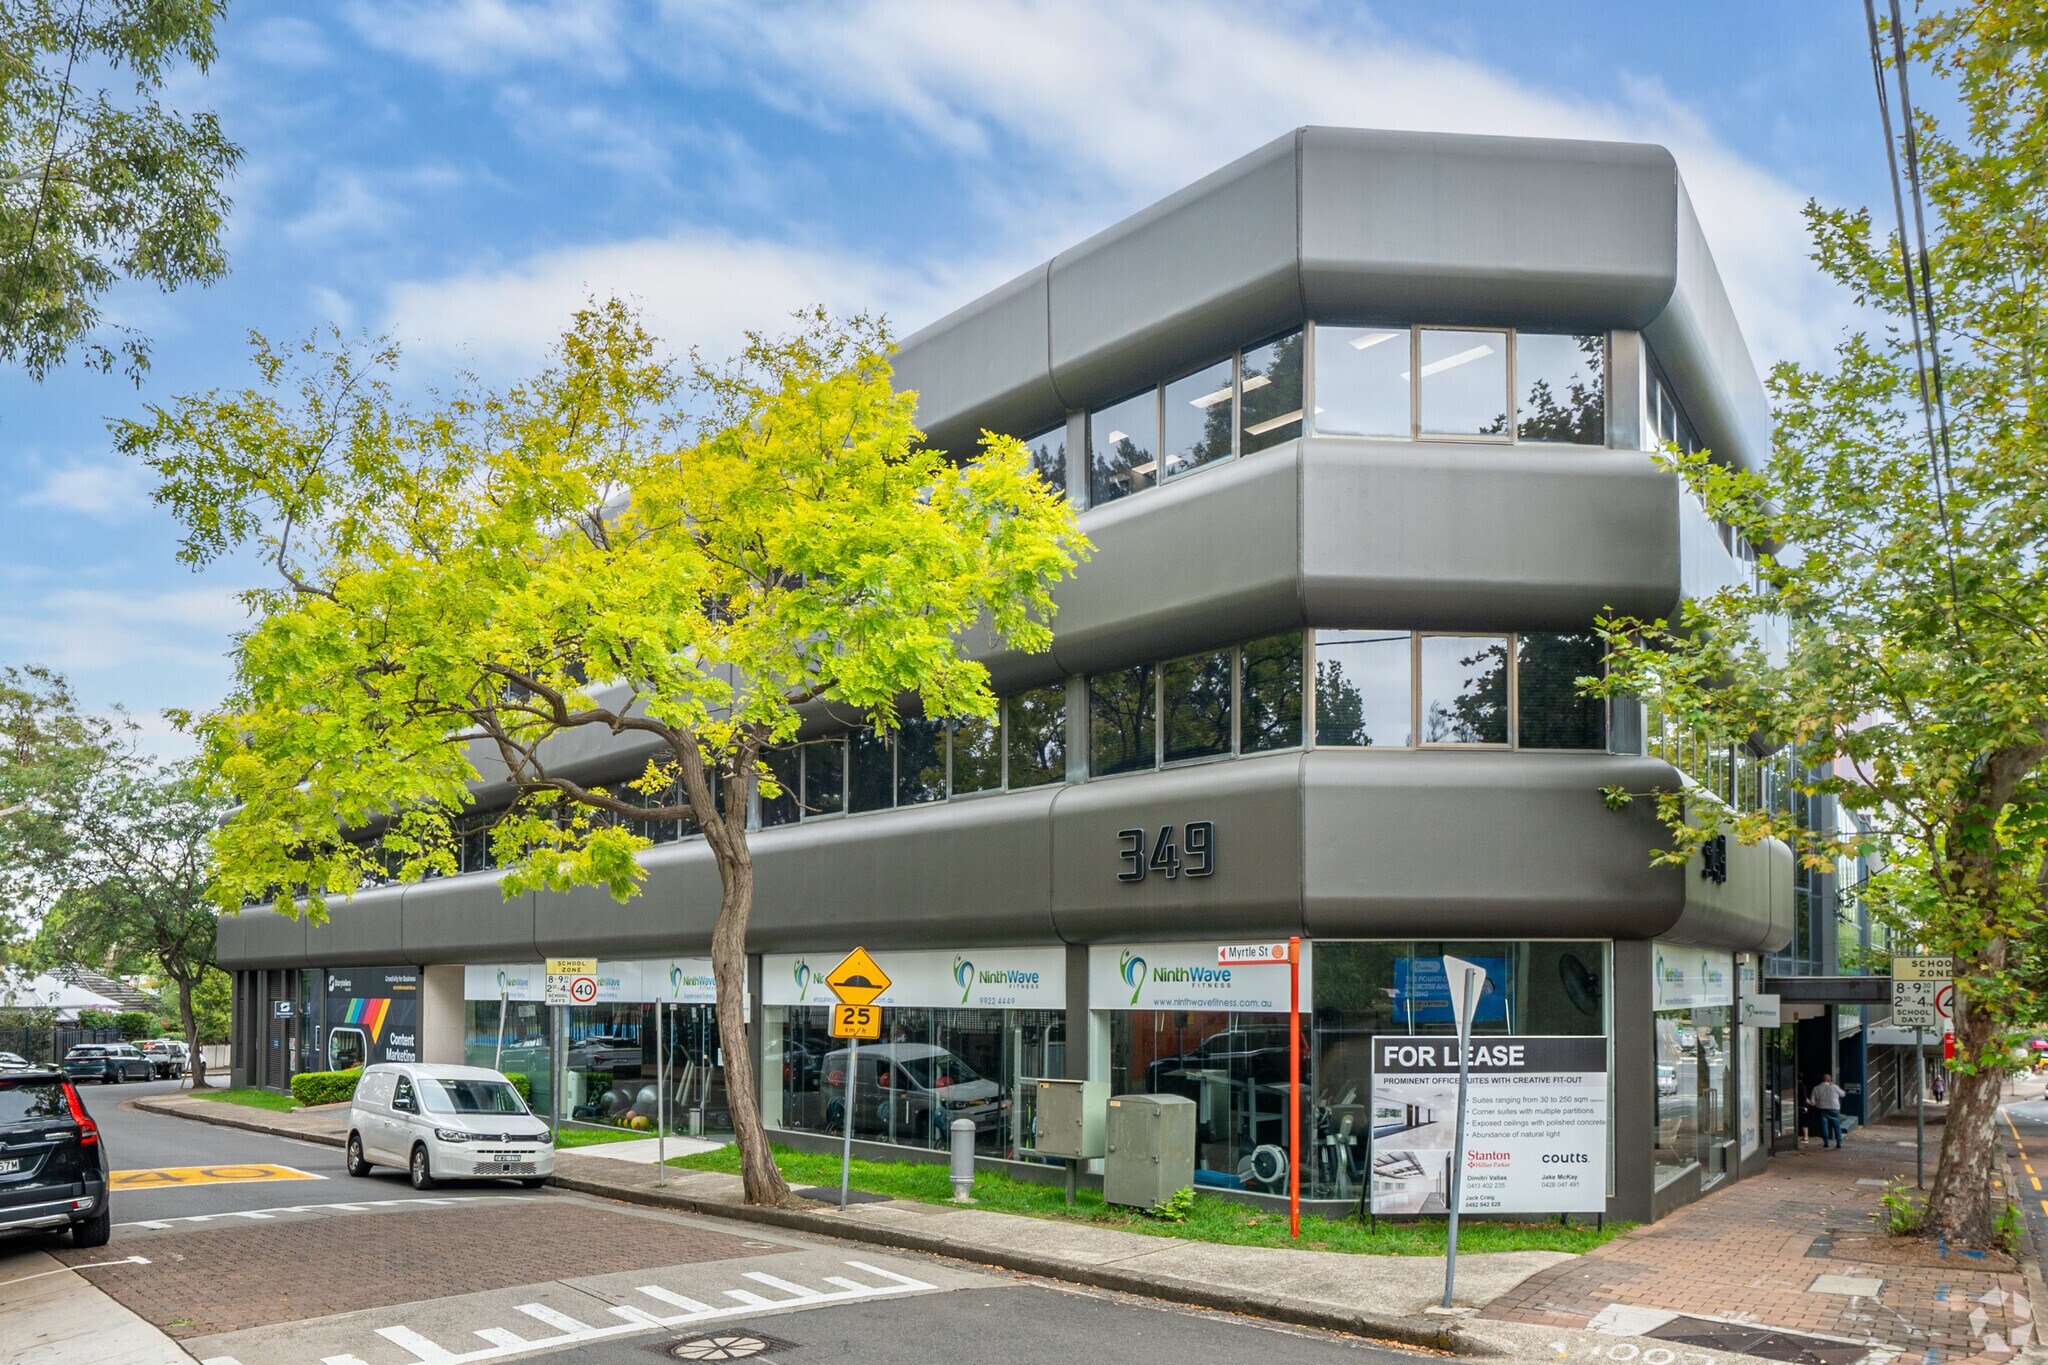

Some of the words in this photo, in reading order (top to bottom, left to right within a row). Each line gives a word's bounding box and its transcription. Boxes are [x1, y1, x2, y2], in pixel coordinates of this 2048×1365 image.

[1117, 821, 1213, 881] 349
[1228, 945, 1256, 960] Myrtle
[1258, 945, 1268, 957] St
[979, 970, 1040, 984] NinthWave
[1153, 967, 1232, 983] NinthWave
[1919, 969, 1953, 977] ZONE
[575, 985, 592, 995] 40
[979, 997, 996, 1005] 9922
[998, 997, 1016, 1005] 4449
[1153, 998, 1272, 1008] www.ninthwavefitness.com.au
[843, 1008, 870, 1025] 25
[845, 1027, 867, 1036] km/h
[390, 1032, 415, 1047] Content
[1384, 1046, 1436, 1067] FOR
[1513, 1076, 1551, 1084] CREATIVE
[1495, 1096, 1521, 1105] ranging
[1534, 1107, 1562, 1116] multiple
[1562, 1107, 1595, 1115] partitions
[1472, 1120, 1502, 1128] Exposed
[1503, 1119, 1529, 1128] ceilings
[1546, 1119, 1576, 1127] polished
[1576, 1118, 1607, 1126] concrete
[1512, 1130, 1520, 1138] of
[1520, 1130, 1545, 1138] natural
[1545, 1130, 1560, 1139] light
[1467, 1150, 1511, 1161] Stanton
[1479, 1194, 1496, 1202] Craig
